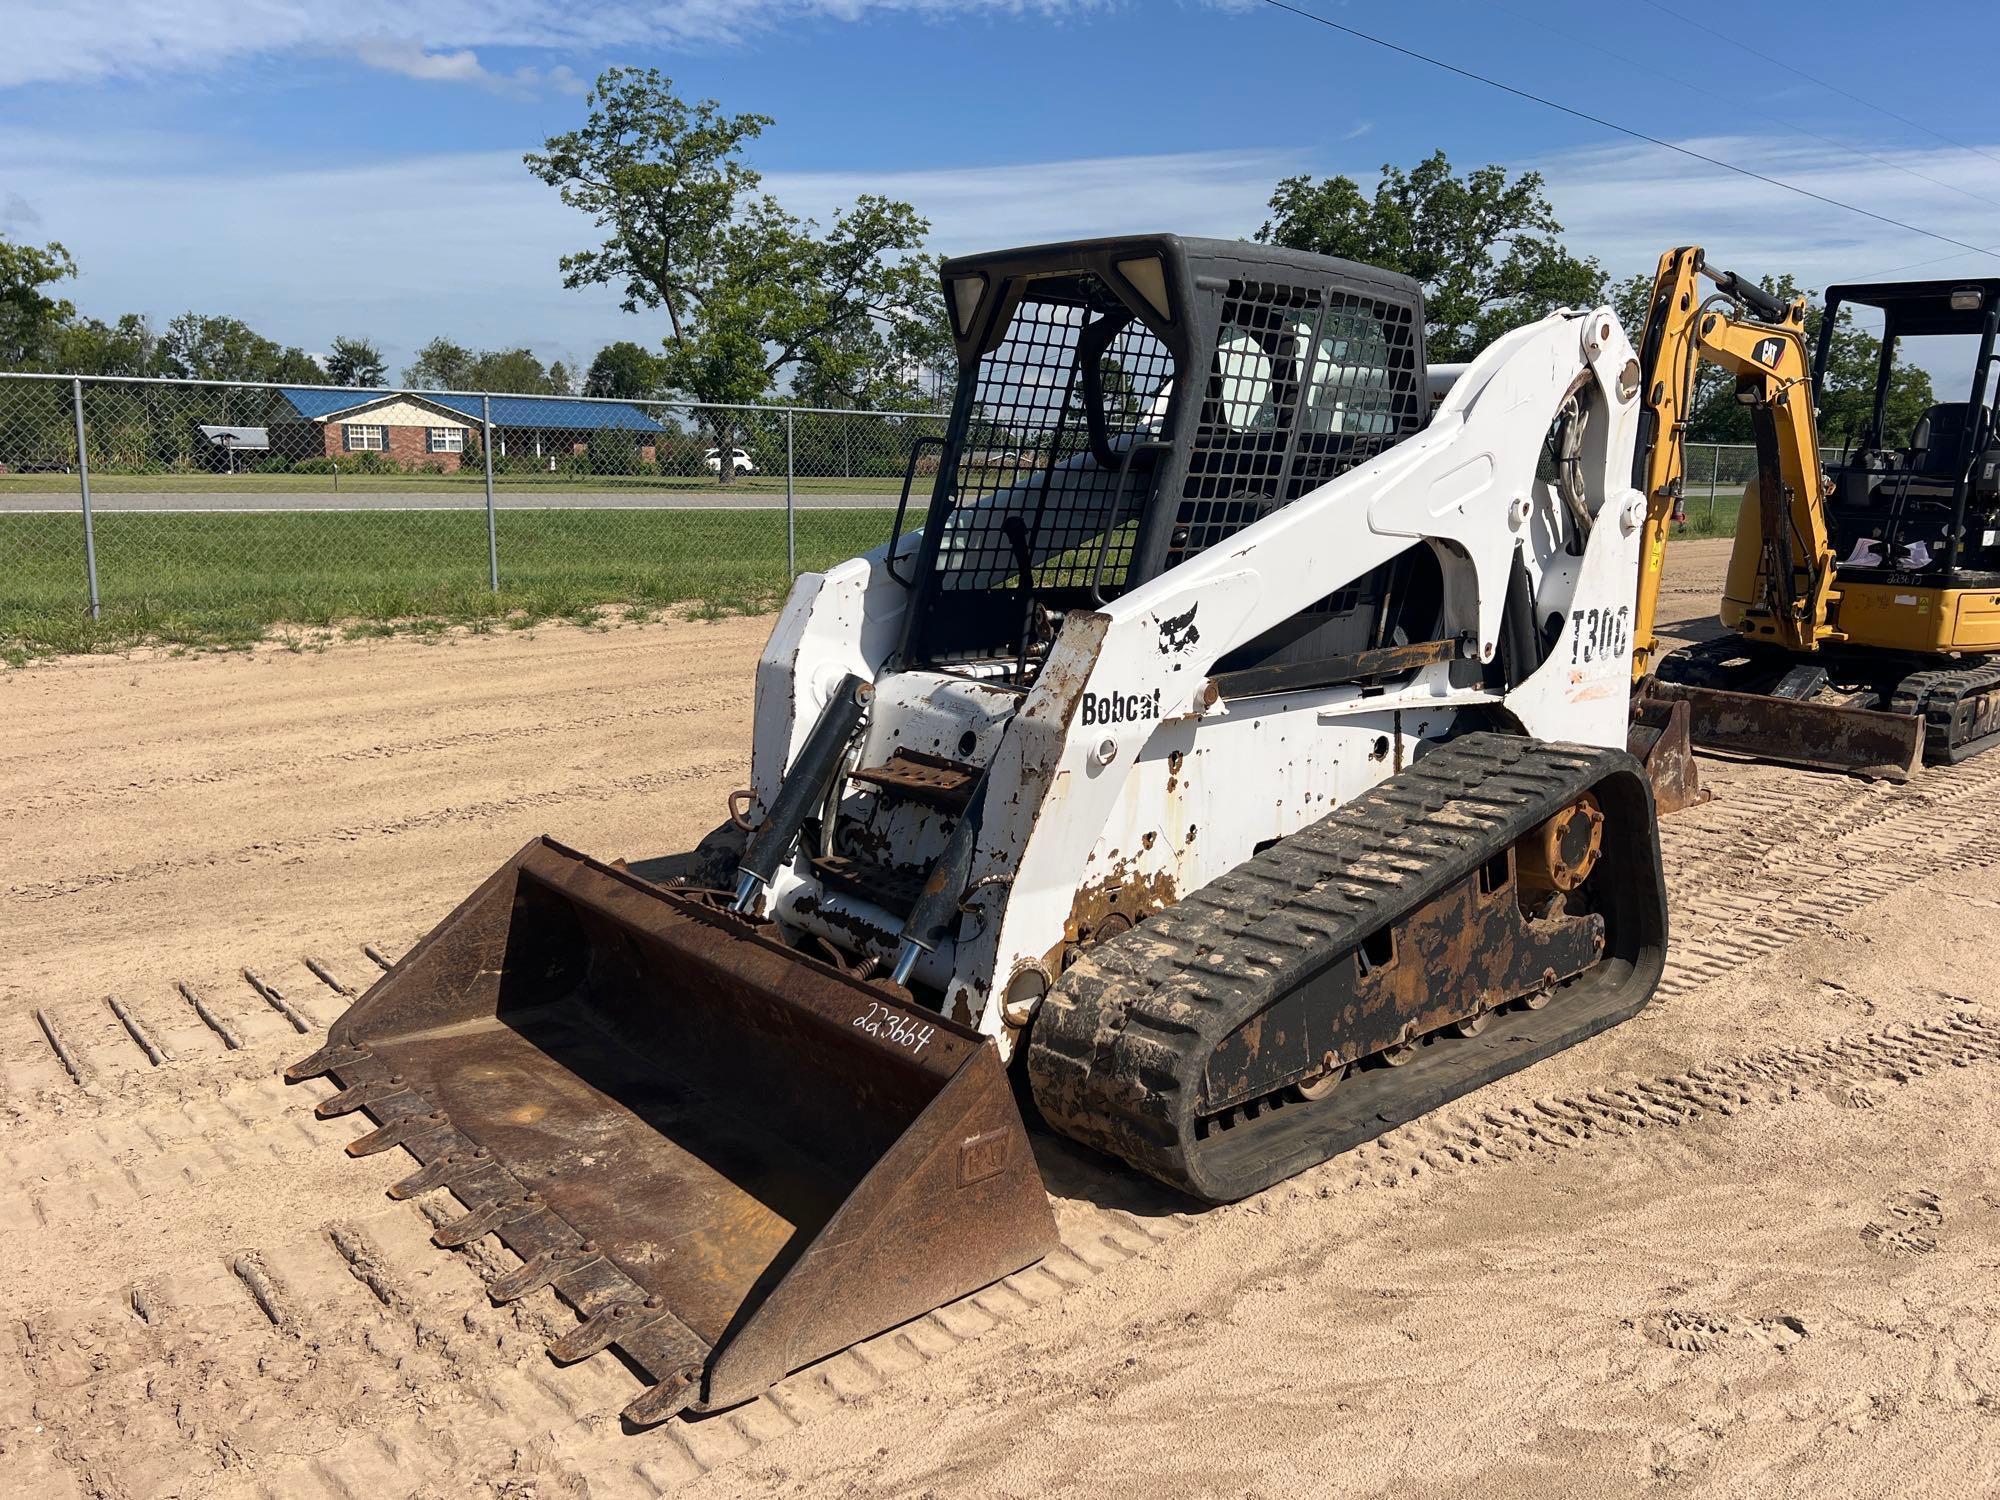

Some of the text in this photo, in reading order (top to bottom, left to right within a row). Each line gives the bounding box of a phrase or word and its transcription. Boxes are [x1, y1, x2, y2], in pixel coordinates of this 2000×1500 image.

[1762, 340, 1778, 367] CAT
[1571, 605, 1629, 665] T300
[1081, 688, 1161, 726] Bobcat
[852, 1002, 935, 1054] 223664
